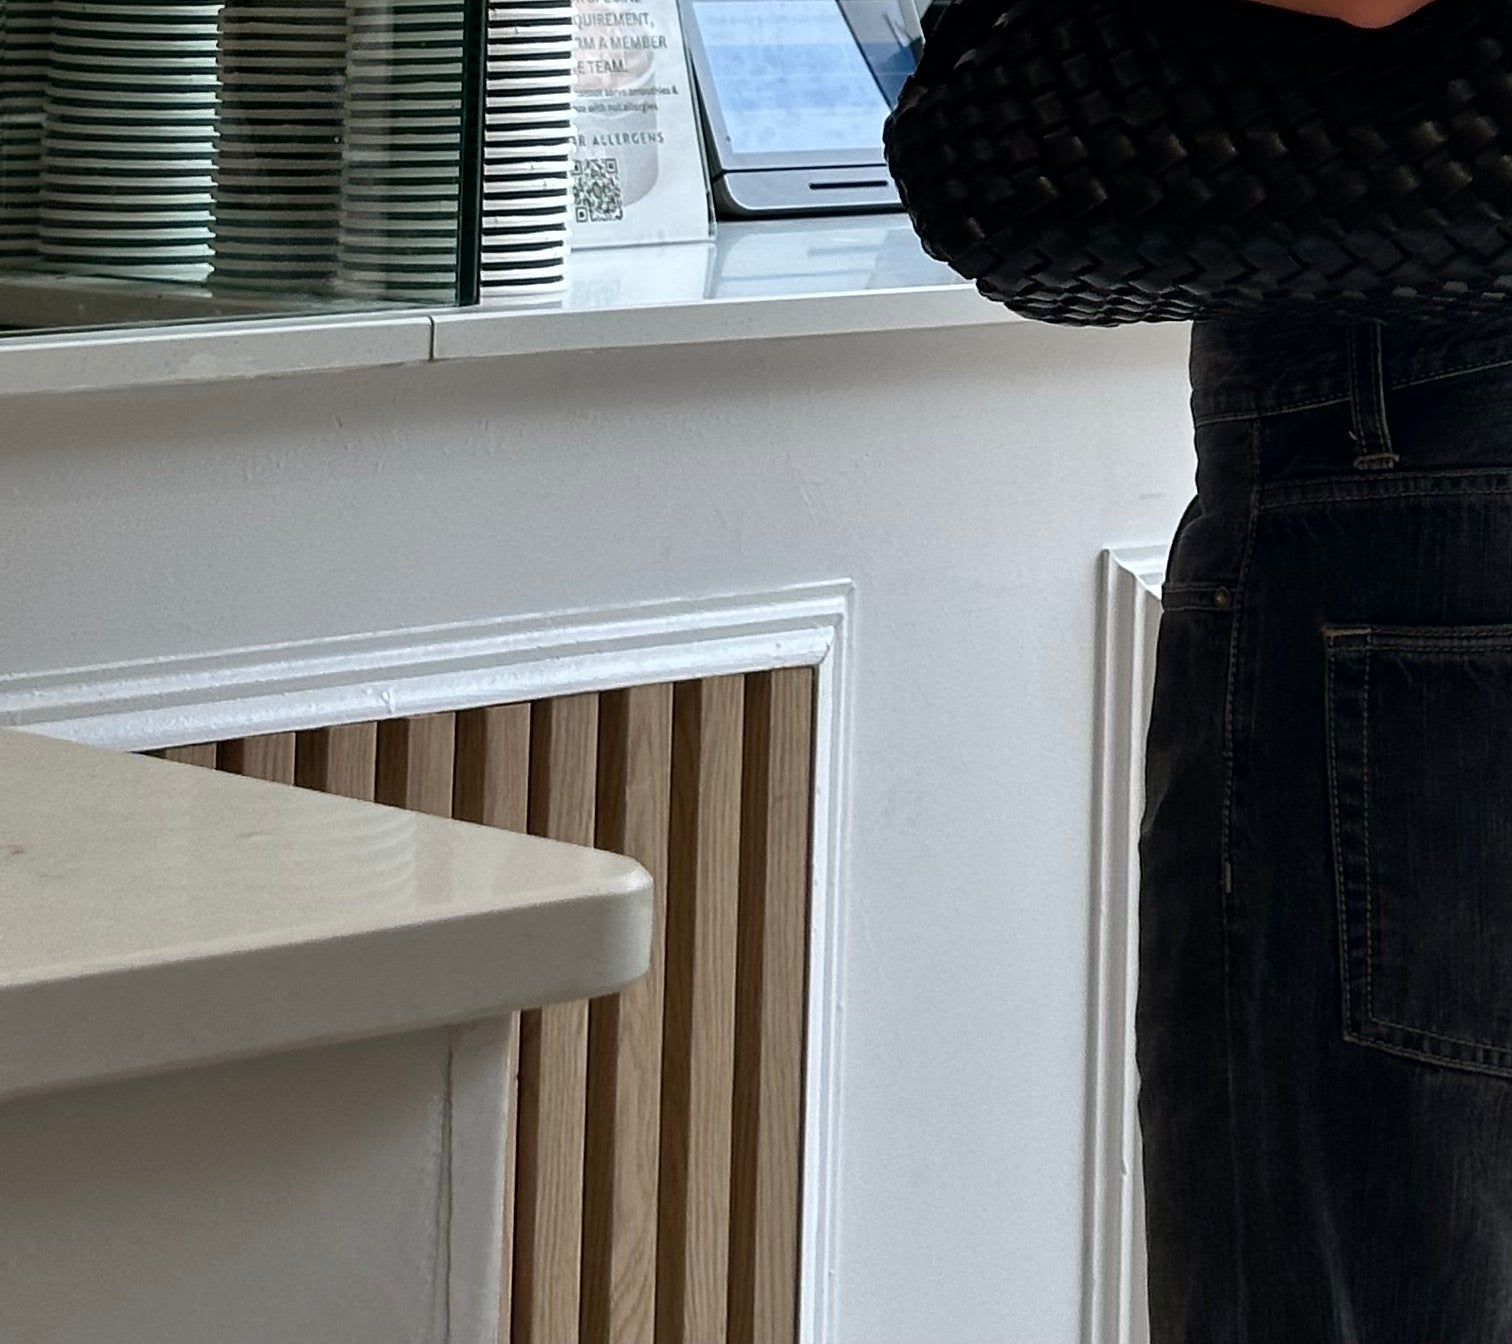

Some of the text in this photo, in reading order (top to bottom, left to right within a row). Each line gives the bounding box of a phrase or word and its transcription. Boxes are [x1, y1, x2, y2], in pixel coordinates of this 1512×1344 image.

[573, 12, 656, 30] QUIREMENT,
[610, 35, 668, 50] MEMBER
[592, 131, 665, 147] ALLERGENS
